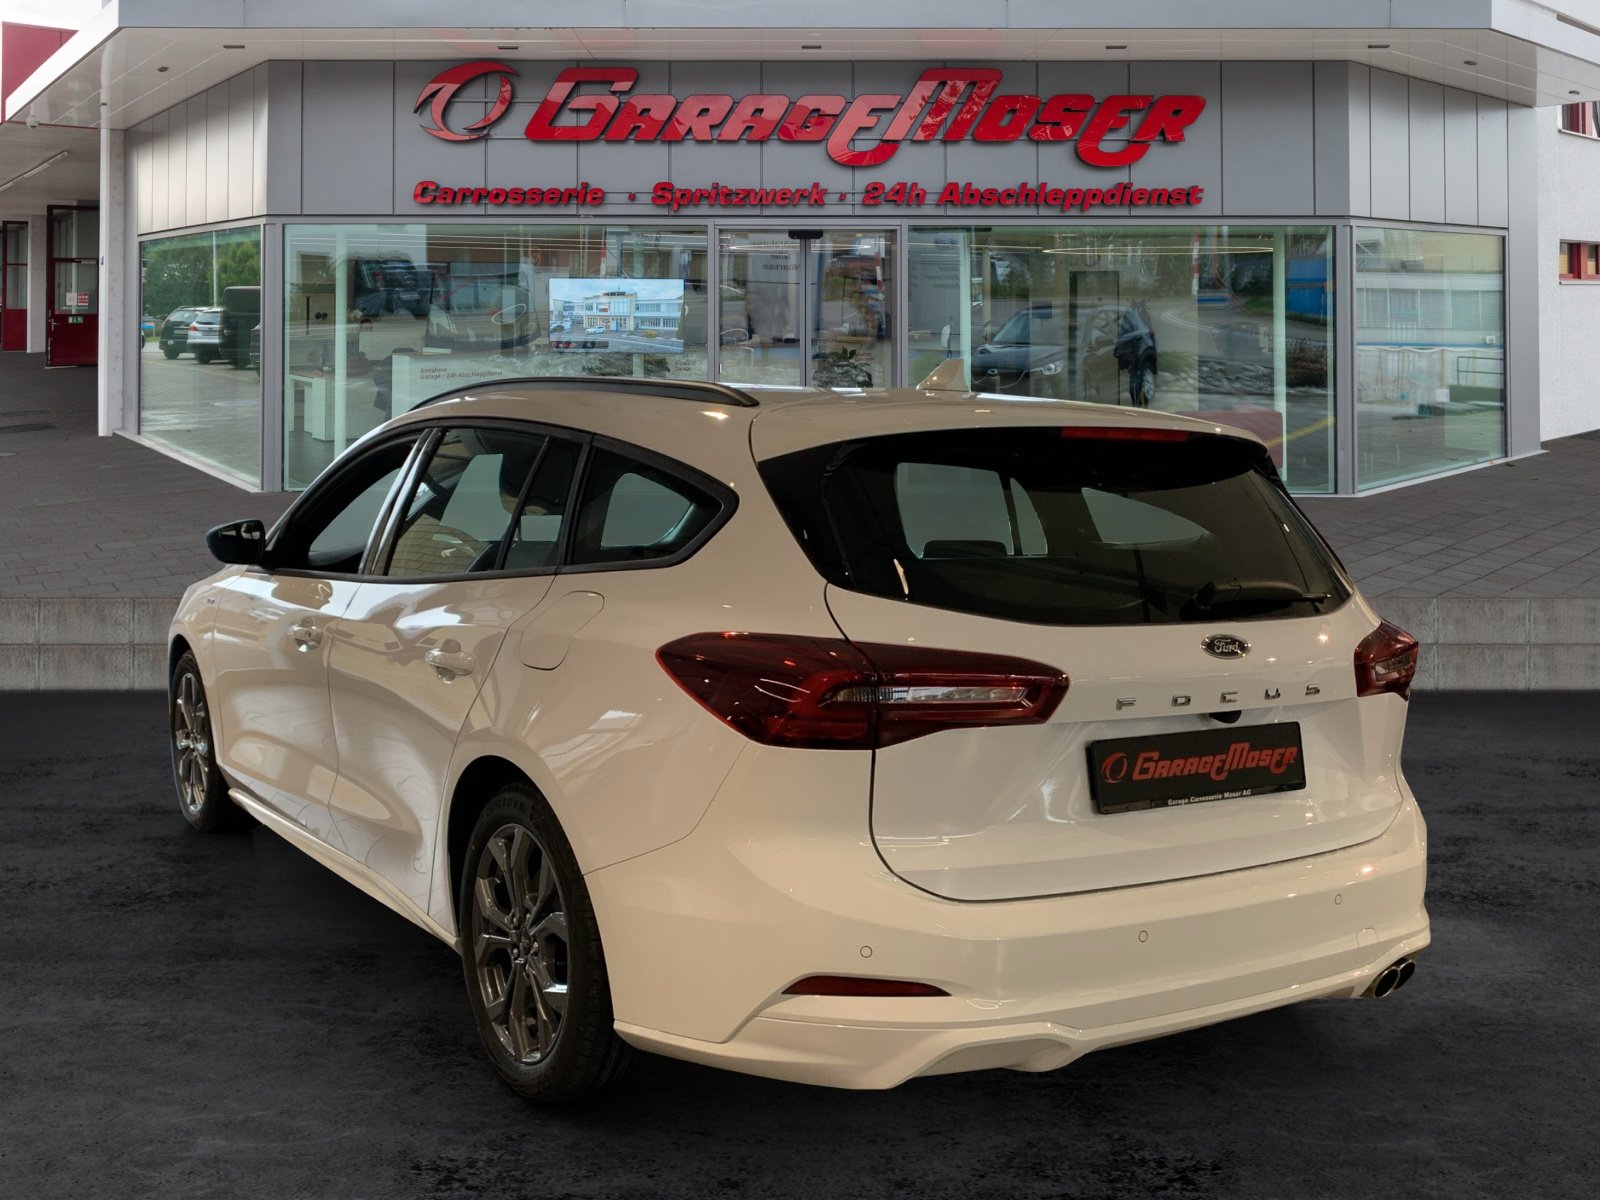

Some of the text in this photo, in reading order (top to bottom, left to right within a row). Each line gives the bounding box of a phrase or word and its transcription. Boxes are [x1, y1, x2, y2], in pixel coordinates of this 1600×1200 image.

[413, 181, 1204, 211] Carrosserie Spritzwerk 24h Abschleppdienst
[458, 370, 503, 378] Abschleppdienst
[1214, 638, 1241, 653] Ford
[1115, 683, 1321, 711] FOCUS
[1190, 794, 1222, 802] Carrosserie
